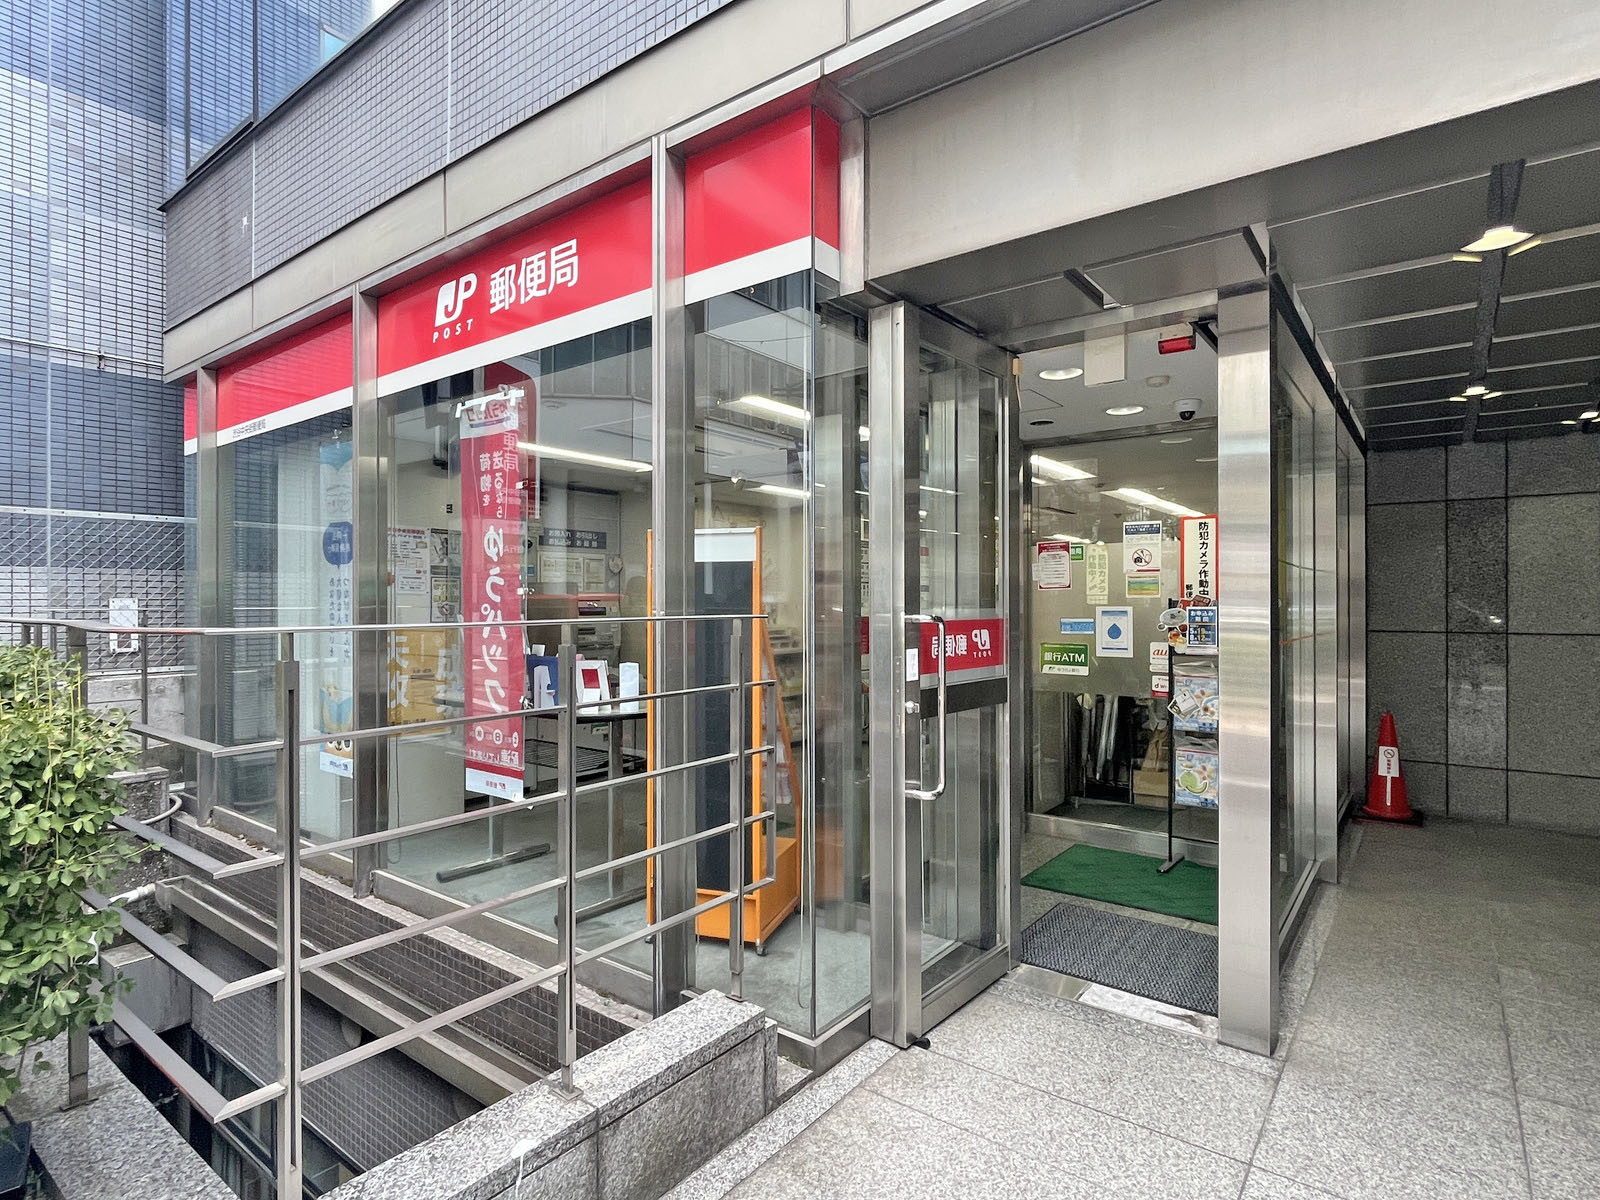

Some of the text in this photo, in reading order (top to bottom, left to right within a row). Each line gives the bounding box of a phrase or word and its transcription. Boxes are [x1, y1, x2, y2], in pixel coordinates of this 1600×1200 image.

[489, 238, 579, 315] 郵便局
[432, 318, 474, 344] POST
[1198, 522, 1209, 596] 防犯カメラ作動中
[1045, 652, 1085, 662] 銀行ATM
